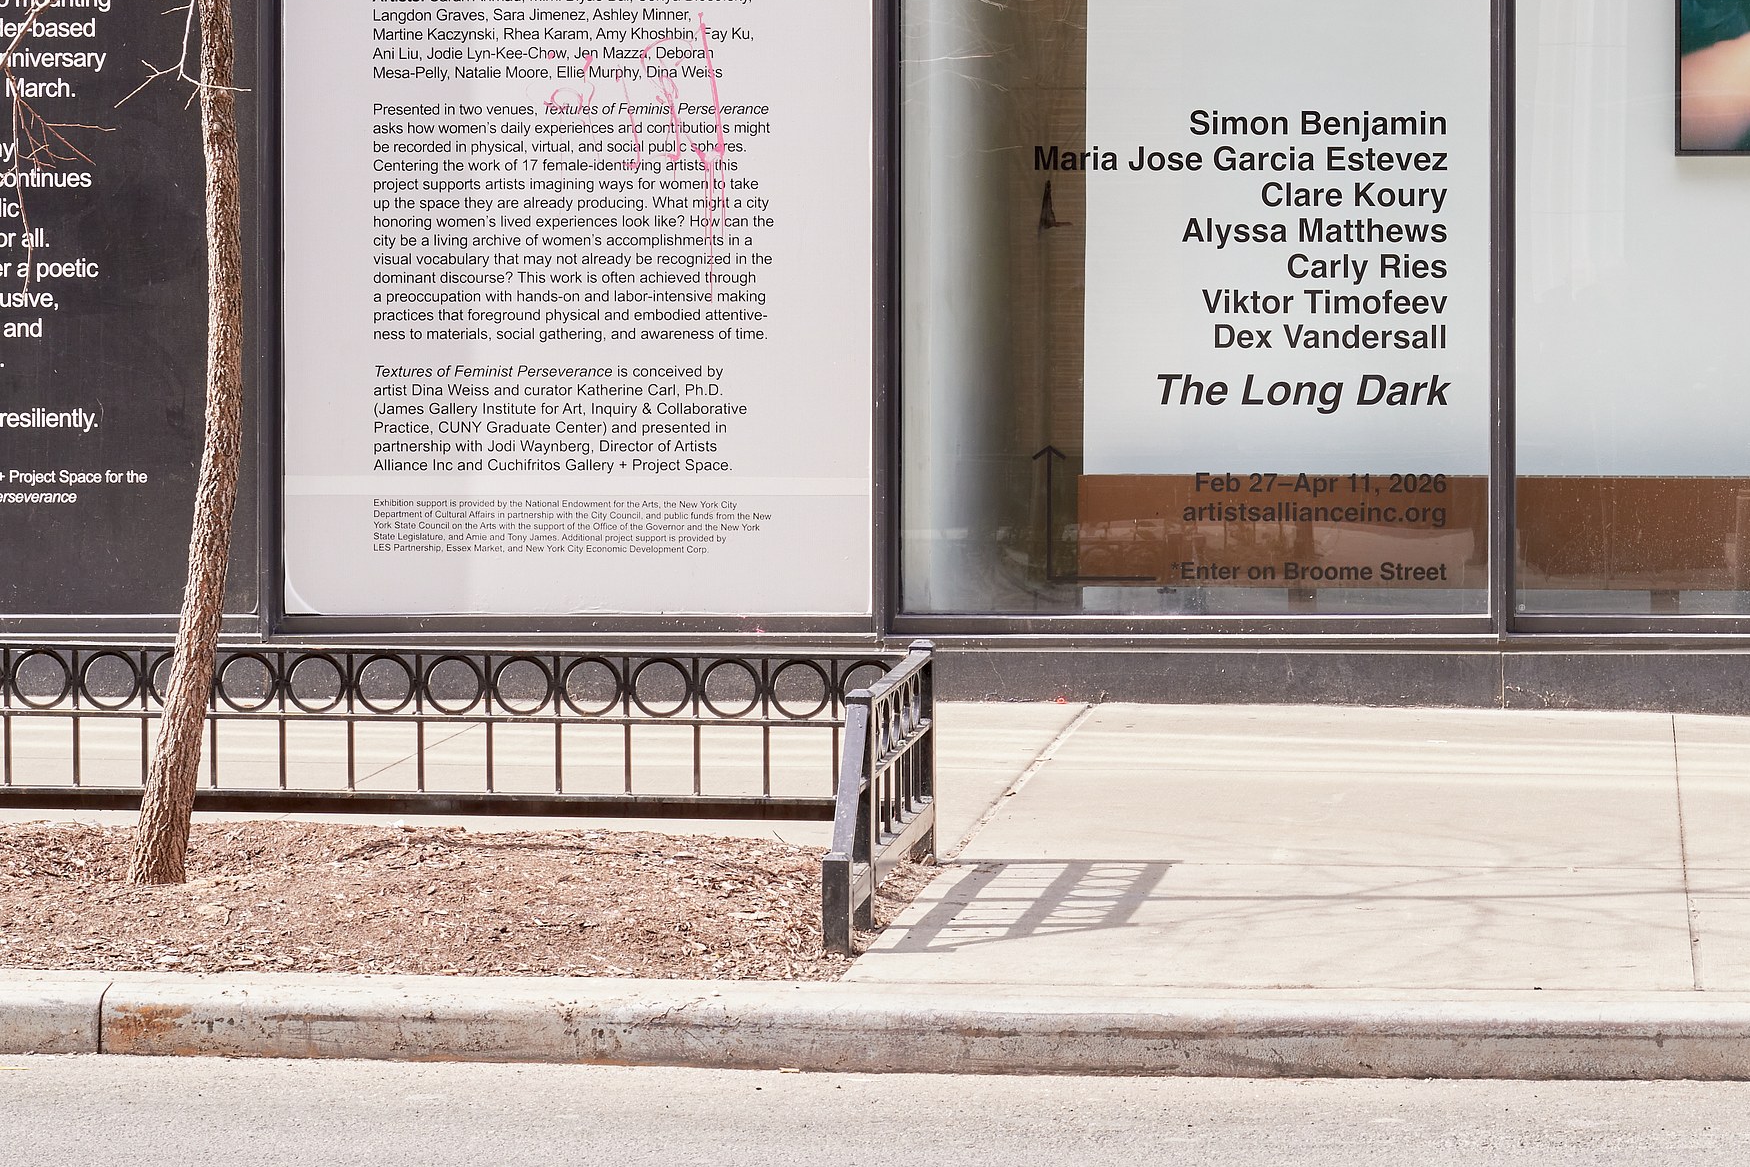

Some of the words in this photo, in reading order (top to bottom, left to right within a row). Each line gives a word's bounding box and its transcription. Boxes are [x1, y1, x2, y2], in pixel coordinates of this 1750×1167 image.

[373, 8, 432, 25] Langdon
[436, 8, 489, 22] Graves,
[493, 8, 525, 22] Sara
[528, 8, 589, 23] Jimenez,
[592, 7, 639, 24] Ashley
[642, 7, 692, 23] Minner,
[5, 77, 77, 98] March.
[1189, 109, 1288, 136] Simon
[1301, 110, 1447, 143] Benjamin
[1033, 145, 1118, 173] Maria
[1128, 145, 1203, 172] Jose
[1213, 145, 1315, 172] Garcia
[1326, 146, 1448, 172] Estevez
[1261, 181, 1343, 208] Clare
[1354, 182, 1448, 214] Koury
[1181, 217, 1287, 250] Alyssa
[1299, 217, 1447, 243] Matthews
[36, 258, 99, 283] poetic
[373, 271, 437, 284] dominant
[439, 270, 514, 284] discourse?
[517, 271, 546, 284] This
[549, 271, 583, 284] work
[586, 271, 598, 284] is
[601, 270, 635, 284] often
[639, 271, 701, 284] achieved
[704, 271, 756, 287] through
[1287, 253, 1369, 286] Carly
[1380, 253, 1448, 279] Ries
[1201, 288, 1294, 315] Viktor
[1303, 289, 1448, 315] Timofeev
[3, 318, 43, 338] and
[1214, 323, 1273, 349] Dex
[1283, 324, 1446, 350] Vandersall
[374, 364, 433, 378] Textures
[436, 364, 452, 378] of
[454, 364, 514, 378] Feminist
[517, 364, 613, 378] Perseverance
[617, 365, 628, 378] is
[632, 364, 702, 378] conceived
[707, 364, 724, 381] by
[373, 383, 408, 397] artist
[411, 383, 444, 397] Dina
[447, 383, 490, 397] Weiss
[493, 383, 520, 397] and
[524, 384, 573, 397] curator
[577, 383, 644, 397] Katherine
[647, 383, 680, 398] Carl,
[685, 383, 723, 396] Ph.D.
[1157, 373, 1228, 406] The
[1241, 374, 1344, 415] Long
[1356, 374, 1452, 406] Dark
[9, 469, 57, 486] Project
[59, 469, 102, 486] Space
[104, 469, 124, 483] for
[126, 469, 148, 483] the
[1194, 472, 1242, 495] Feb
[1388, 472, 1448, 494] 2026
[1182, 499, 1448, 528] artistsallianceinc.org
[373, 543, 392, 552] LES
[393, 543, 444, 554] Partnership,
[446, 543, 472, 553] Essex
[473, 543, 505, 553] Market,
[507, 544, 523, 553] and
[525, 544, 545, 553] New
[546, 544, 565, 553] York
[567, 544, 584, 555] City
[585, 544, 628, 553] Economic
[629, 544, 685, 555] Development
[1247, 565, 1277, 582] on
[1283, 560, 1374, 582] Broome
[1379, 560, 1448, 582] Street
